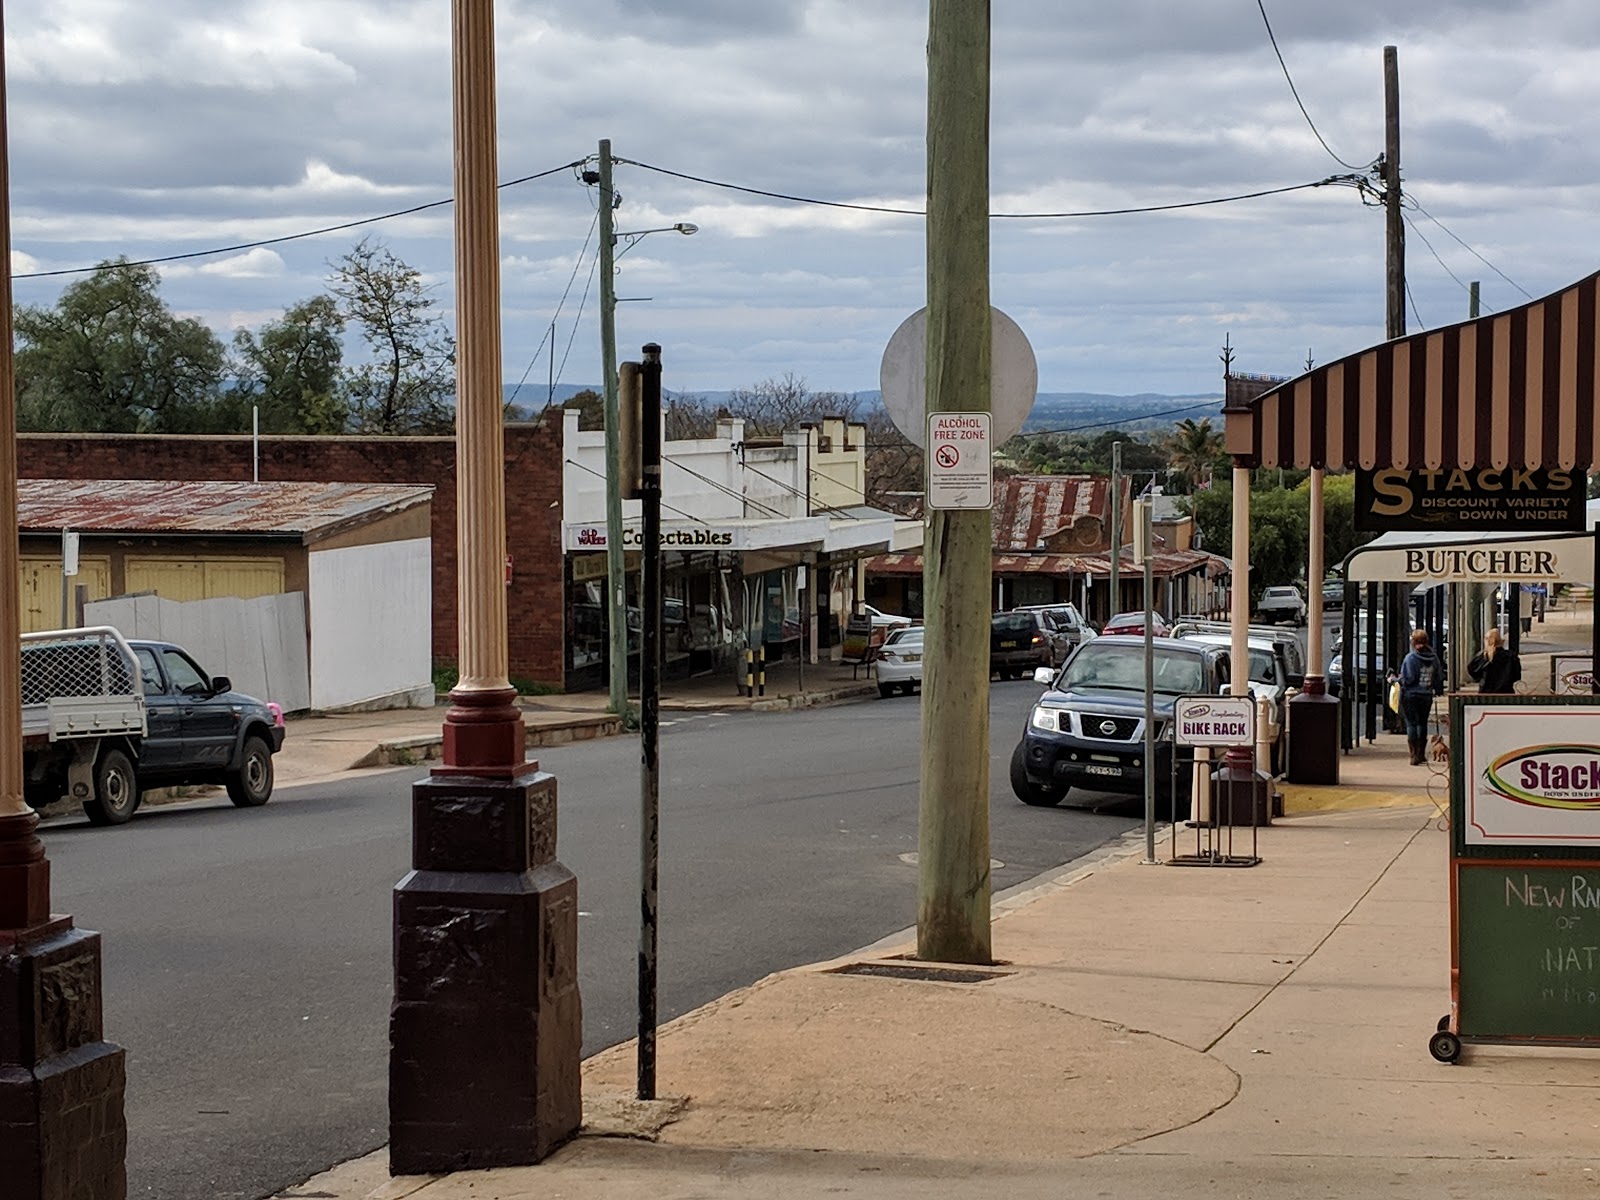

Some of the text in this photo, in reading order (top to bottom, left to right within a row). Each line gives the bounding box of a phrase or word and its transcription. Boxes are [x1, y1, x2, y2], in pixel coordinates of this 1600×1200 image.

[938, 419, 981, 428] ALCOHOL
[934, 430, 985, 440] FREE ZONE
[1370, 467, 1573, 516] STACKS
[1421, 498, 1570, 508] DISCOUNT VARIETY
[1459, 510, 1568, 520] DOWN UNDER
[581, 529, 598, 537] OLD
[622, 528, 733, 545] Coectables
[1405, 549, 1558, 577] BUTCHER
[1183, 722, 1246, 736] BIKE RACK
